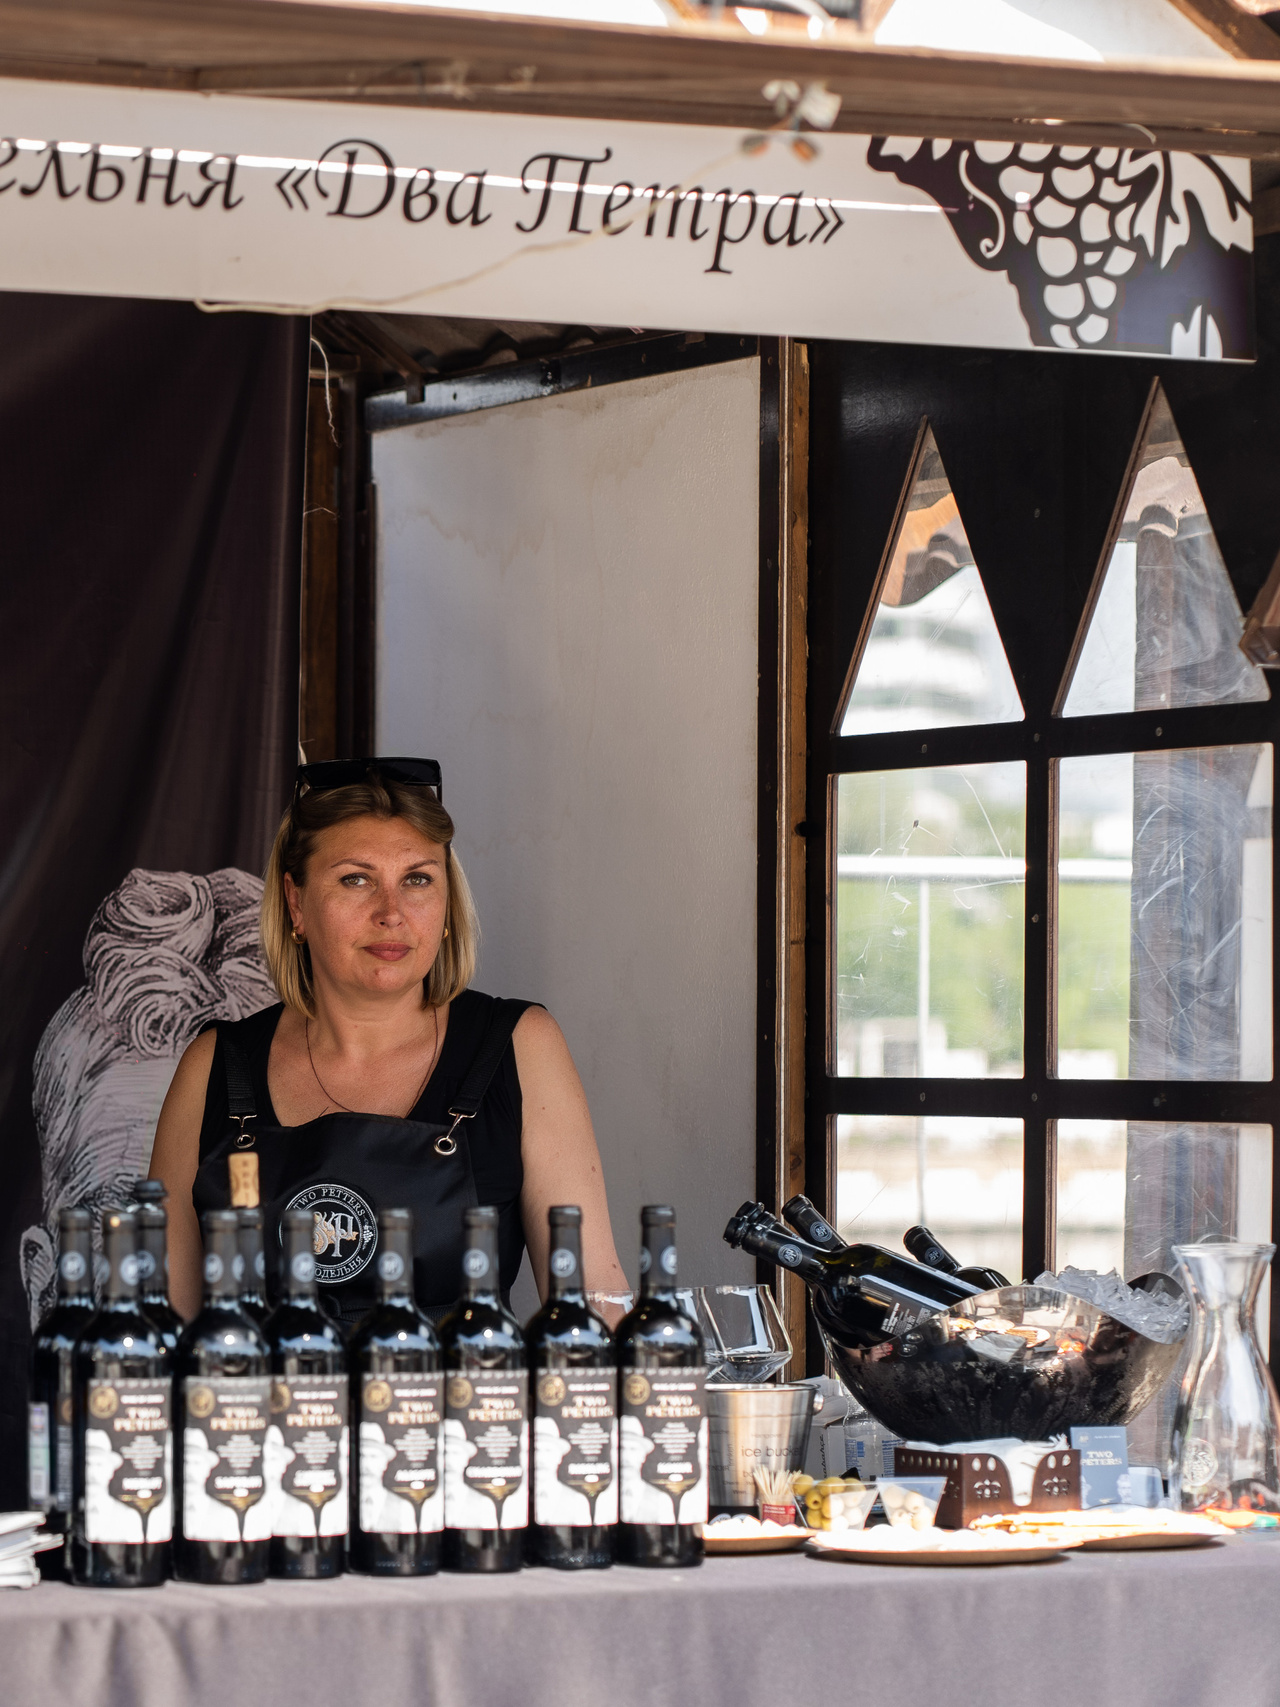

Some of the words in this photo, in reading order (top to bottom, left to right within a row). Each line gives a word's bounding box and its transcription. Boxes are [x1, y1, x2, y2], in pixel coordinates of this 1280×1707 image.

[276, 138, 492, 227] «Два
[515, 146, 845, 274] Петра»
[293, 1191, 316, 1210] TWO
[322, 1188, 366, 1217] PETTERS
[314, 1255, 364, 1278] ОДЕЛЬНЯ
[741, 1446, 762, 1457] ice
[1086, 1451, 1114, 1459] TWO
